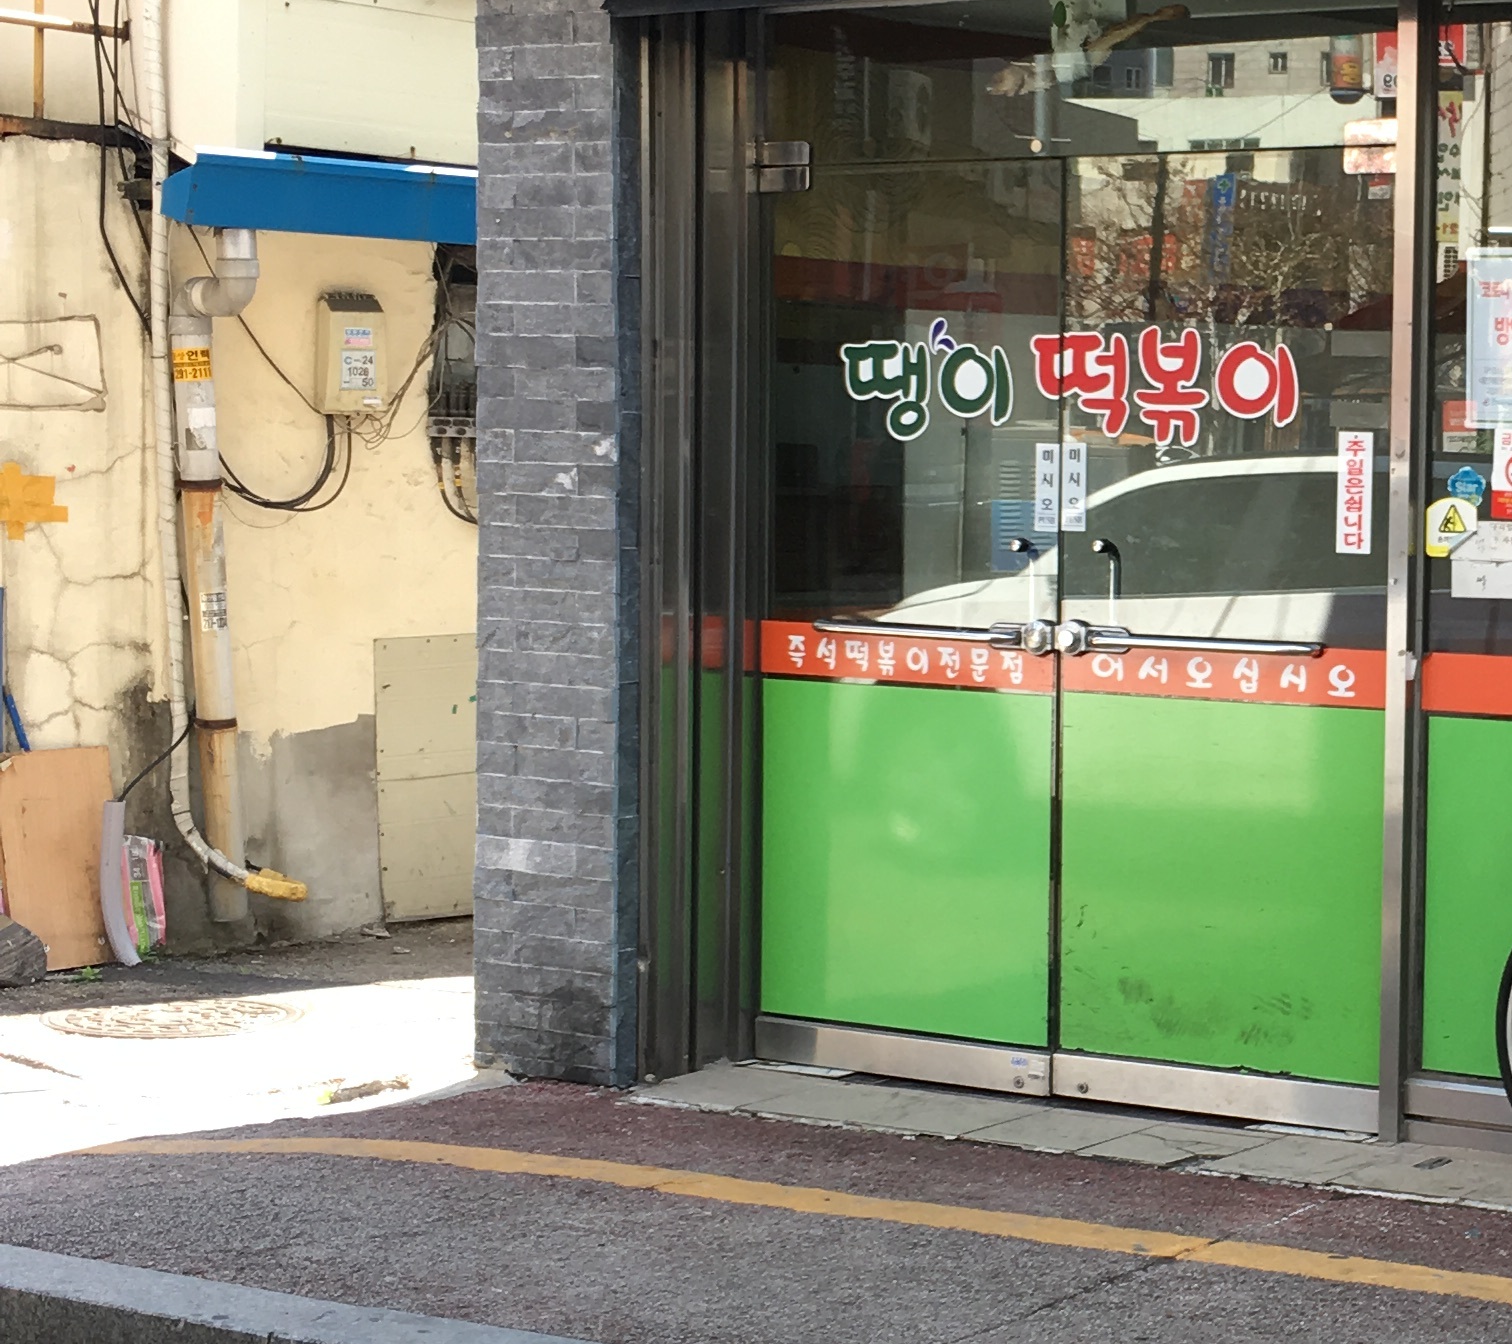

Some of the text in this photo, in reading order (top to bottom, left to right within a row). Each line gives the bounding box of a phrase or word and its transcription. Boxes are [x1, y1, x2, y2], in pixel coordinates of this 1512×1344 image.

[840, 325, 1300, 447] 땡이 떡볶이
[1042, 449, 1054, 511] 미시오
[787, 635, 1357, 699] 즉석떡볶이전문점 어서오십시오
